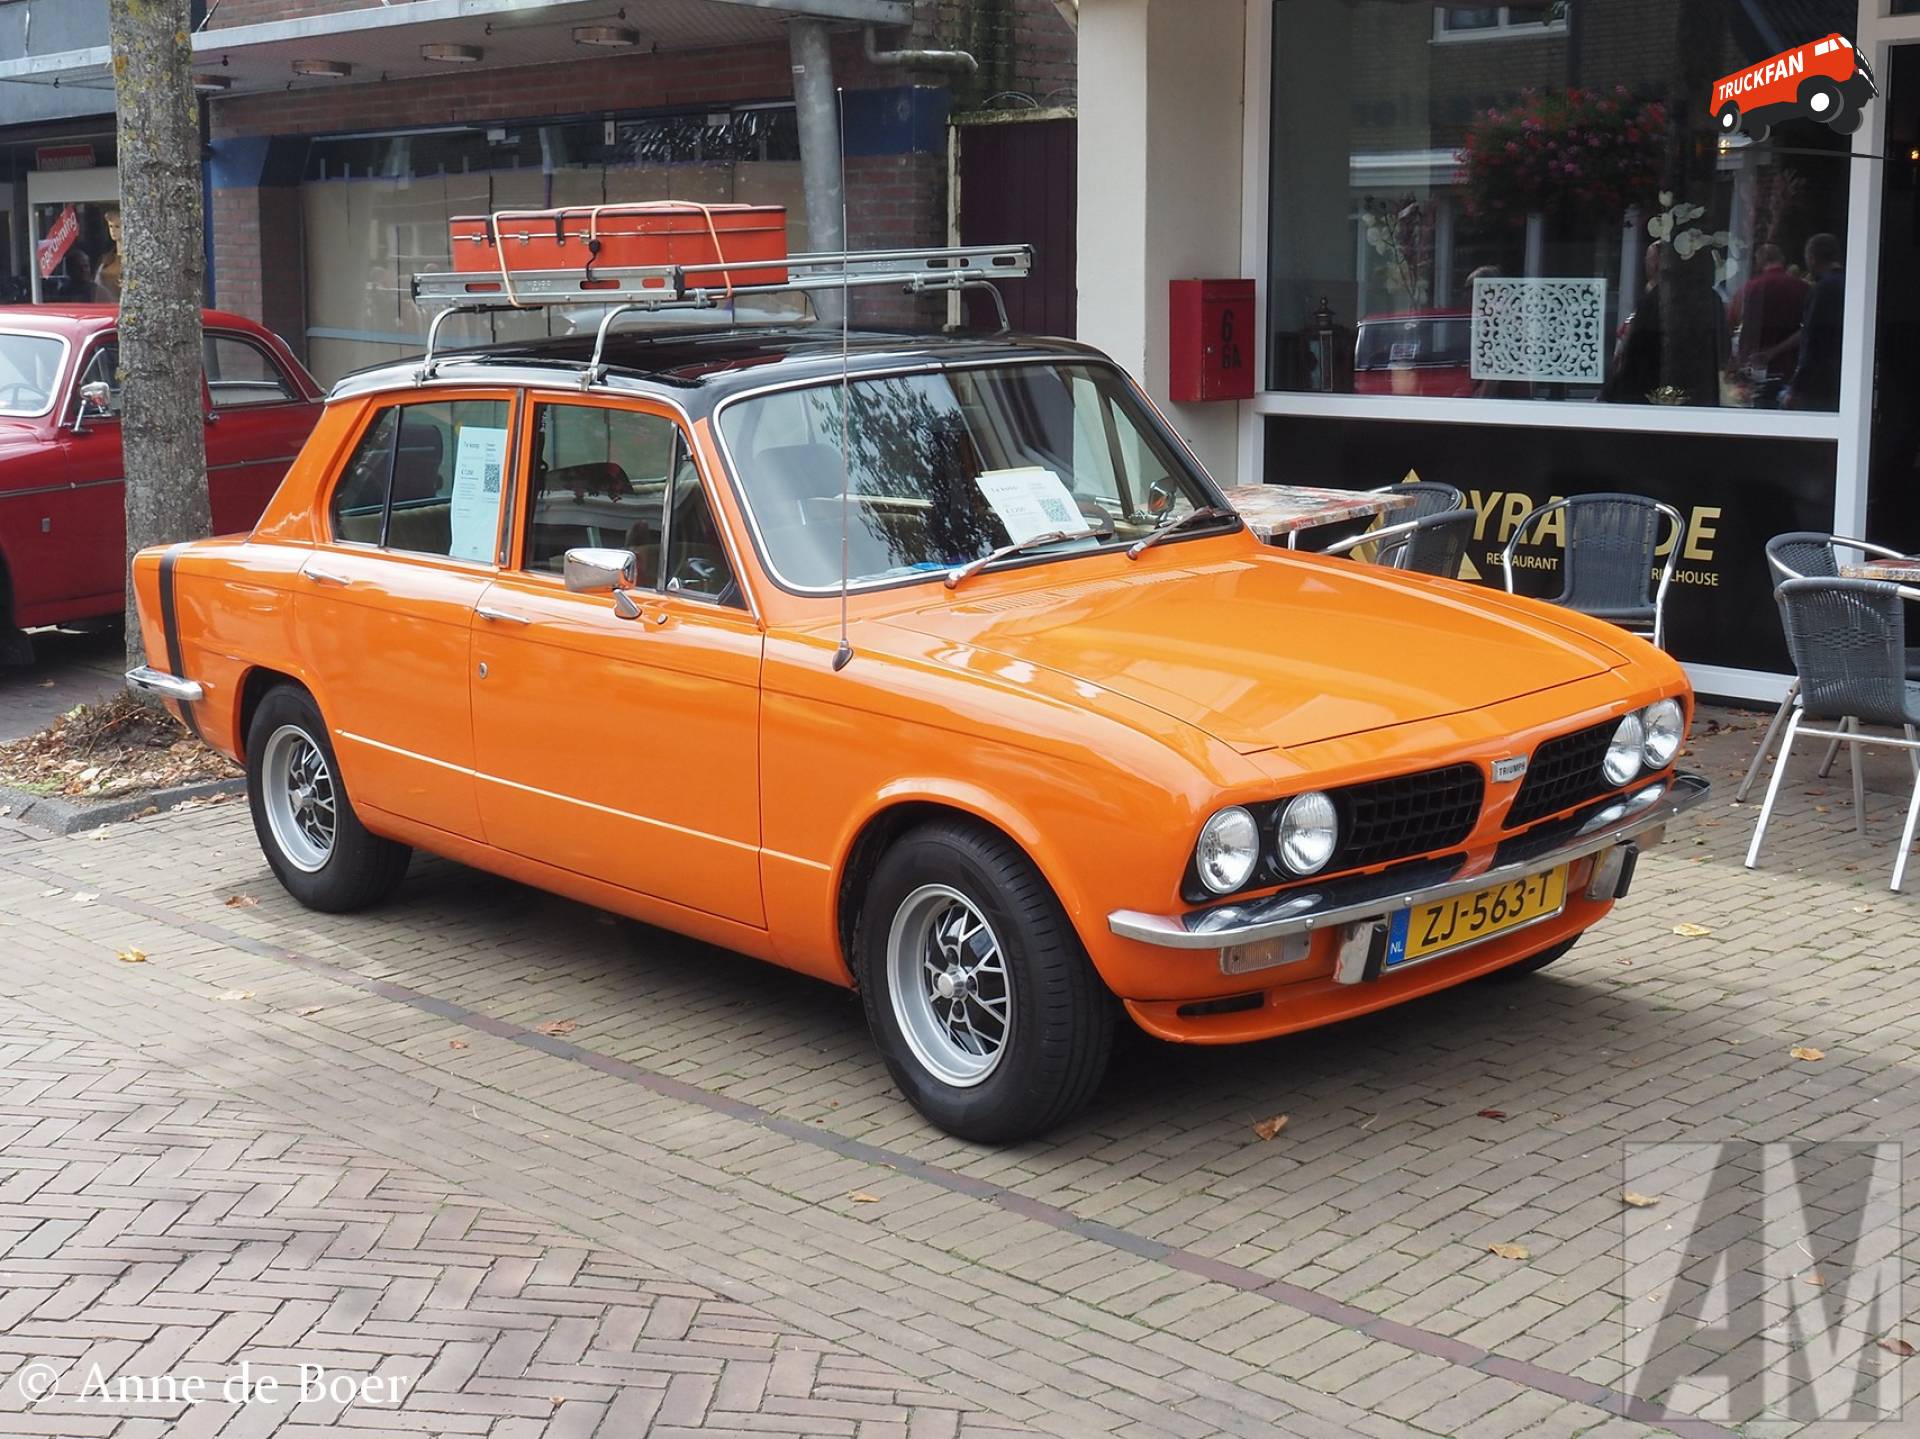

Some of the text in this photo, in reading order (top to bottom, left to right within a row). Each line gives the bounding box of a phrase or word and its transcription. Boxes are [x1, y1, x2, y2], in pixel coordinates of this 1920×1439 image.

[1222, 307, 1234, 342] 6
[1222, 344, 1242, 369] 6A
[1497, 761, 1526, 777] TRIUMPH
[1421, 868, 1554, 947] ZJ-563-T
[1389, 940, 1404, 955] NL
